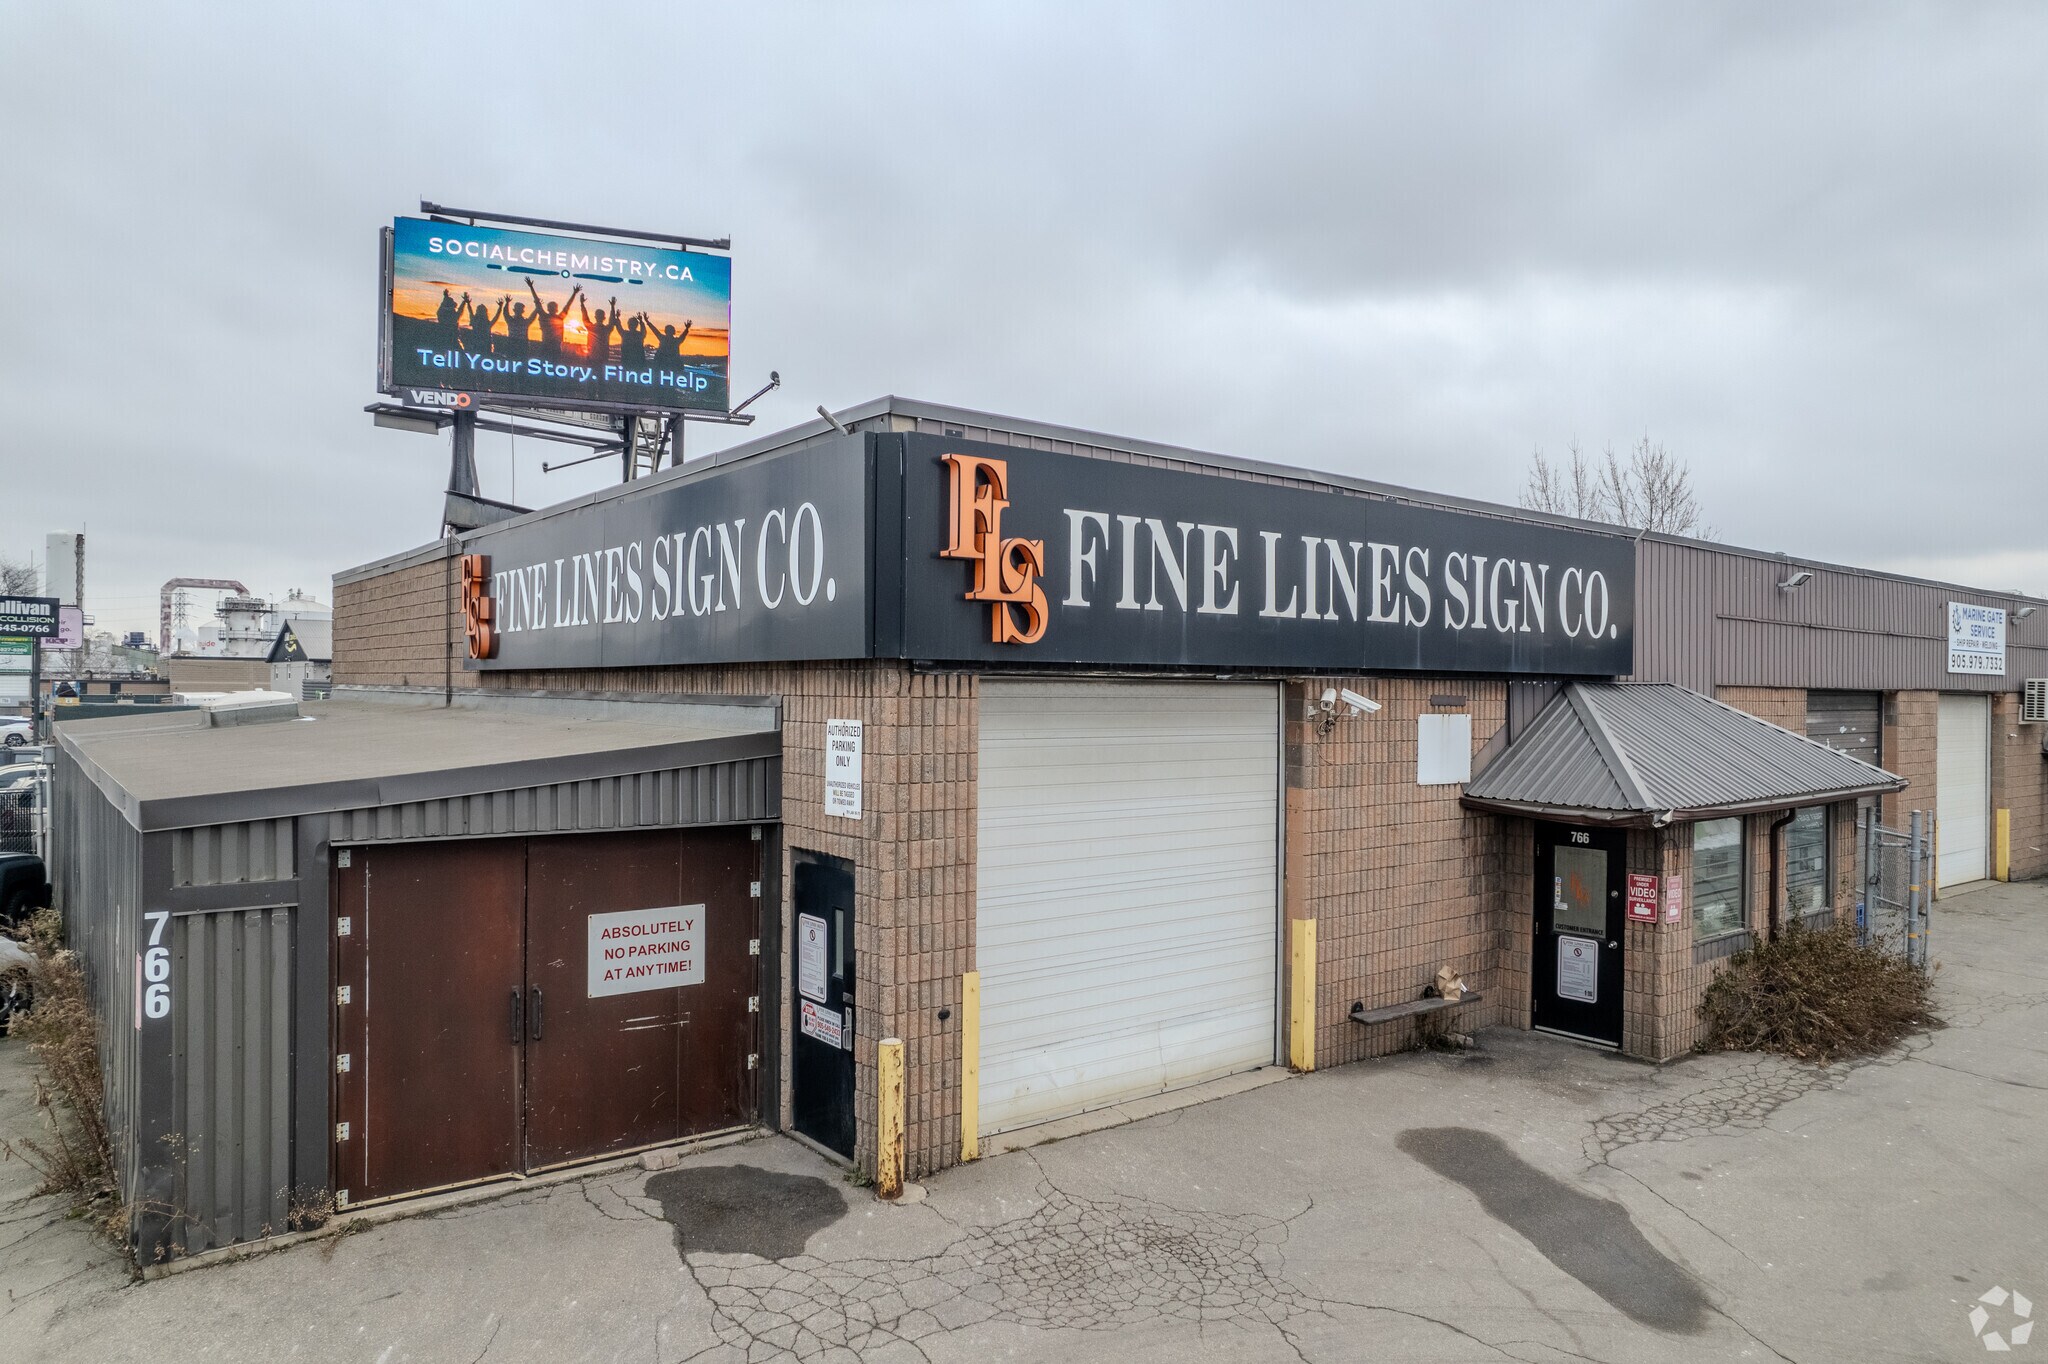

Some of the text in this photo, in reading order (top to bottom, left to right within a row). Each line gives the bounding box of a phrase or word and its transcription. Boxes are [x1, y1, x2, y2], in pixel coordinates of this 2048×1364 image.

[429, 237, 694, 282] SOCIALCHEMISTRY.CA
[417, 348, 708, 390] Tell Your Story. Find Help
[410, 389, 471, 408] VENDO
[494, 502, 836, 634] FINE LINES SIGN CO.
[1062, 508, 1618, 639] FINE LINES SIGN CO.
[0, 615, 55, 624] COLLISION
[1962, 607, 2003, 625] MARINE GATE
[1970, 624, 1995, 639] SERVICE
[1951, 654, 2003, 671] 905.979.7332
[828, 725, 861, 738] AUTHORIZED
[832, 740, 855, 753] PARKING
[835, 755, 851, 767] ONLY
[1571, 832, 1590, 844] 766
[1630, 887, 1656, 898] VIDEO
[601, 919, 694, 940] ABSOLUTELY
[1555, 923, 1604, 936] CUSTOMER ENTRANCE
[604, 940, 691, 960] NO PARKING
[144, 911, 170, 1019] 766
[603, 968, 623, 981] AT
